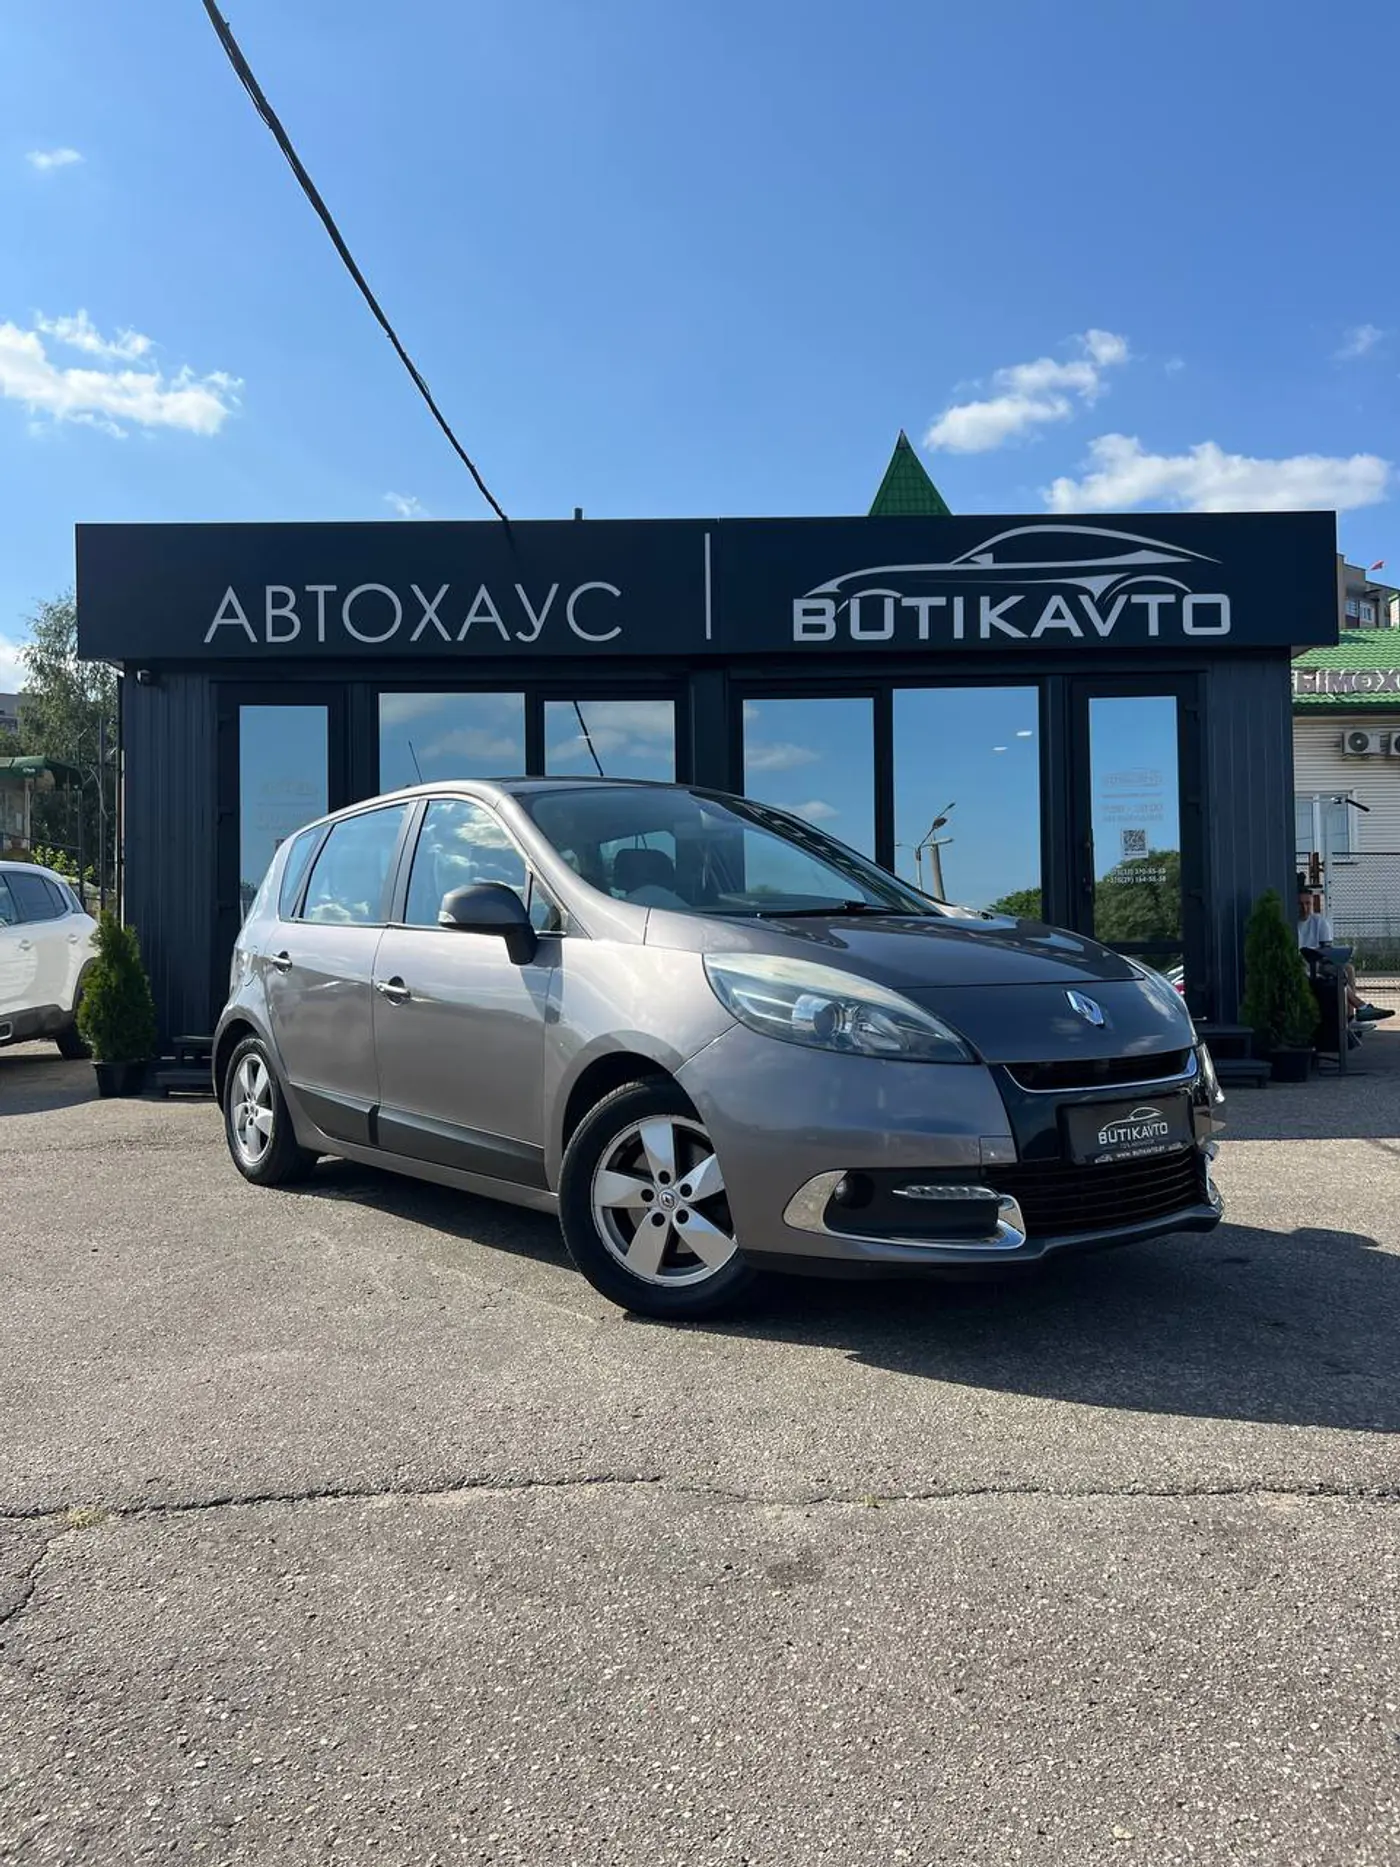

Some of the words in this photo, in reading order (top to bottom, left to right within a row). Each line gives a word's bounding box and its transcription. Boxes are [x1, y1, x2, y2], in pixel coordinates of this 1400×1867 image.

[204, 581, 622, 643] АВТОХАУС
[793, 593, 1231, 641] BUTIKAVTO
[1098, 1122, 1169, 1145] BUTIKAVTO
